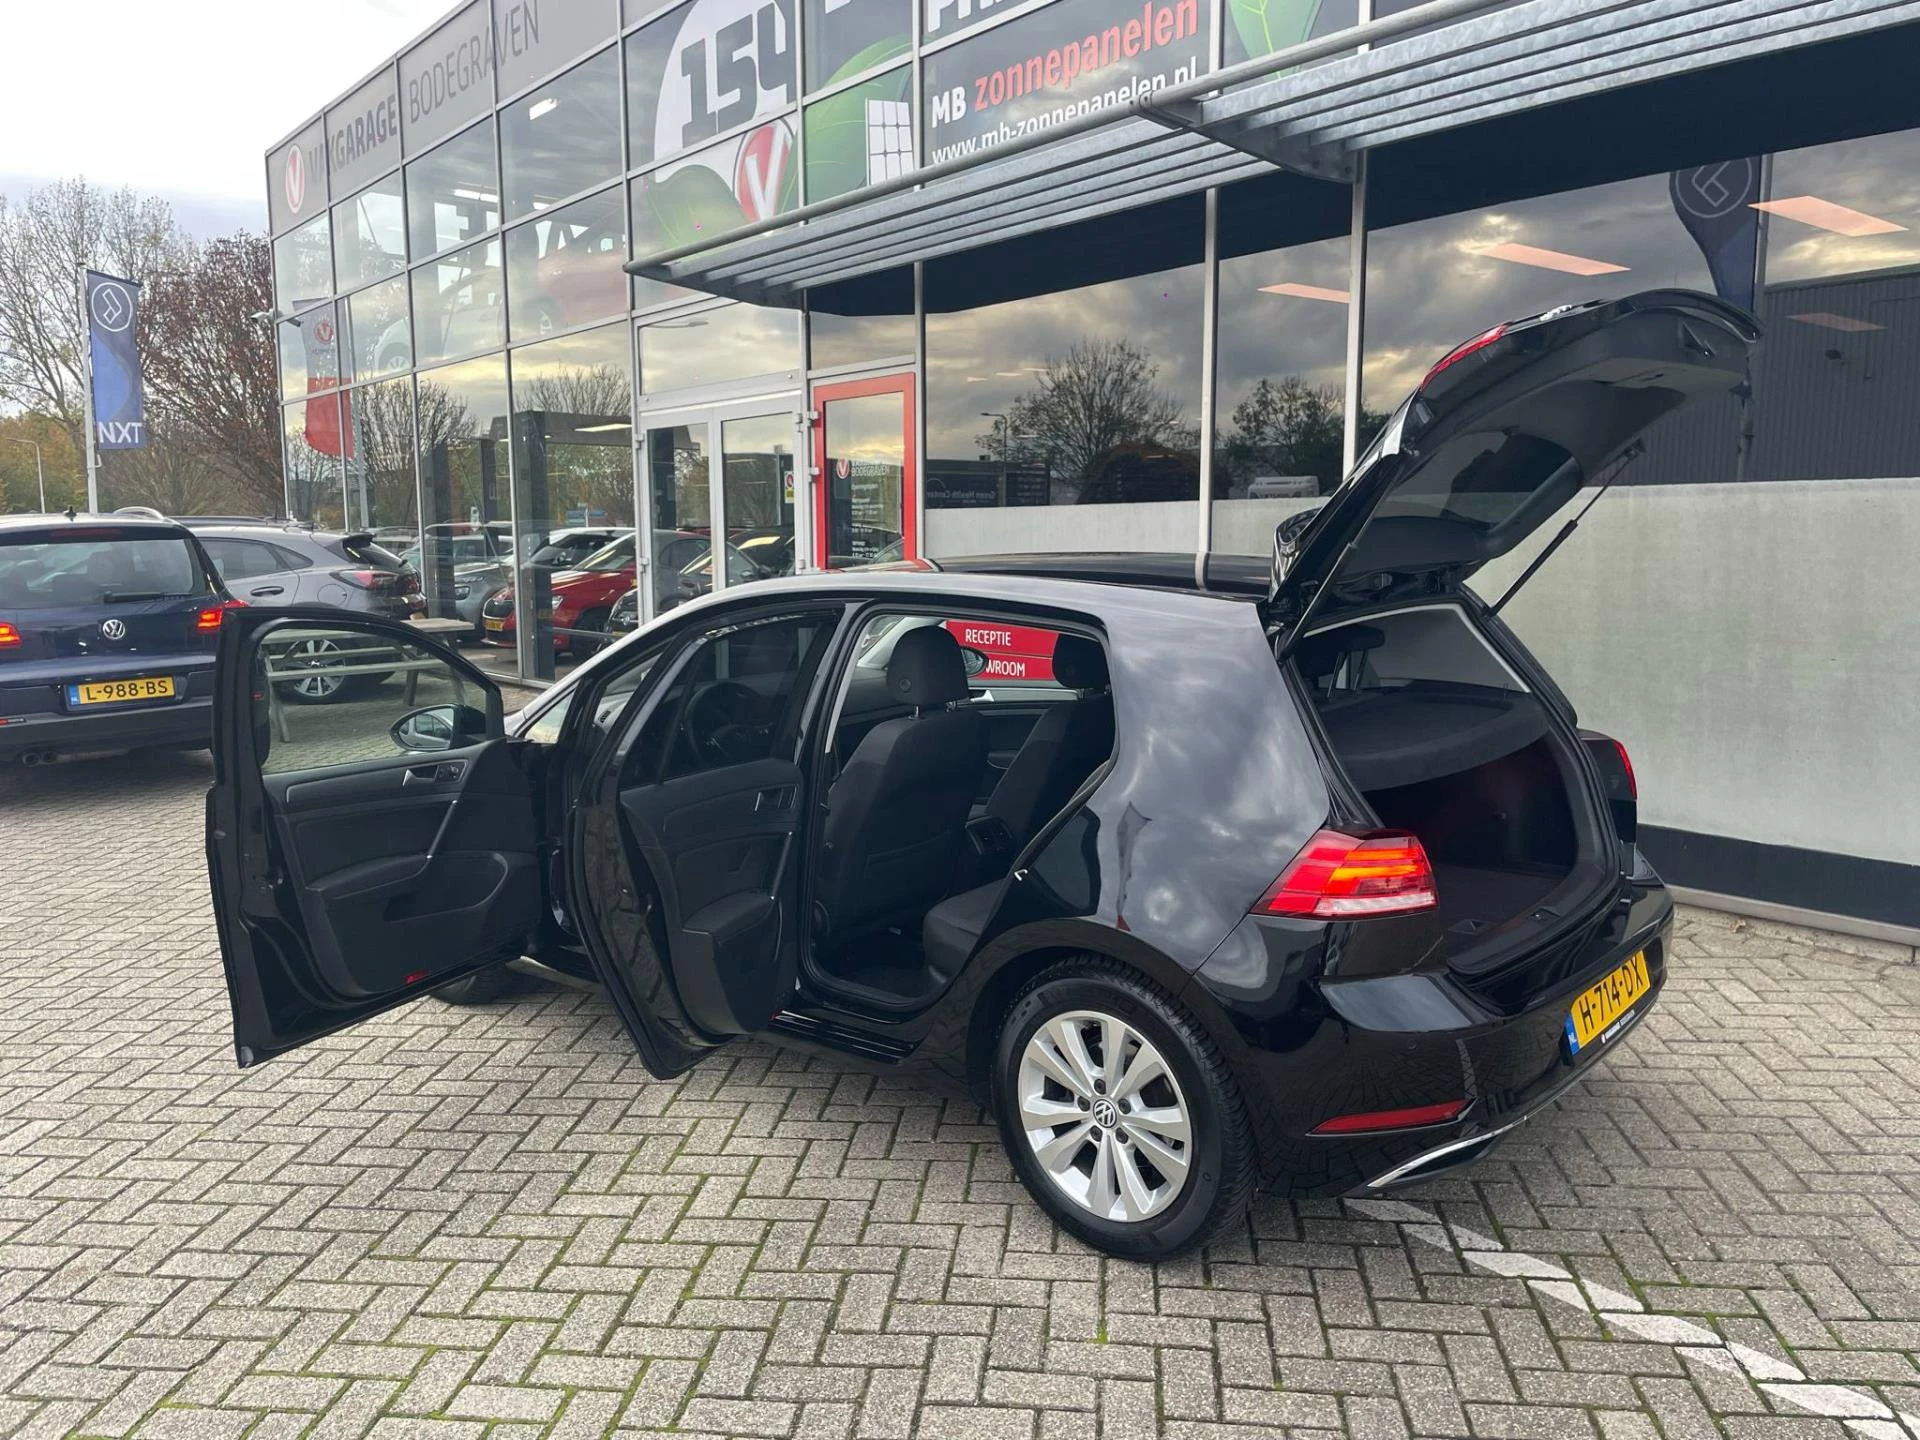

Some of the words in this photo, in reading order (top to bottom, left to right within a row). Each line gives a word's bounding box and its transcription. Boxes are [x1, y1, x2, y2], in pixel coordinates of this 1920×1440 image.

[409, 0, 539, 124] BODEGRAVEN
[680, 3, 797, 149] 154
[931, 86, 967, 129] MB
[974, 0, 1199, 112] zonnepanelen
[932, 55, 1197, 165] www.mb-zonnepanelennl
[98, 421, 143, 444] NXT
[965, 628, 1012, 647] RECEPTIE
[985, 659, 1026, 677] WROOM
[85, 680, 168, 701] L-988-BS
[1578, 953, 1644, 1035] H-714-DX
